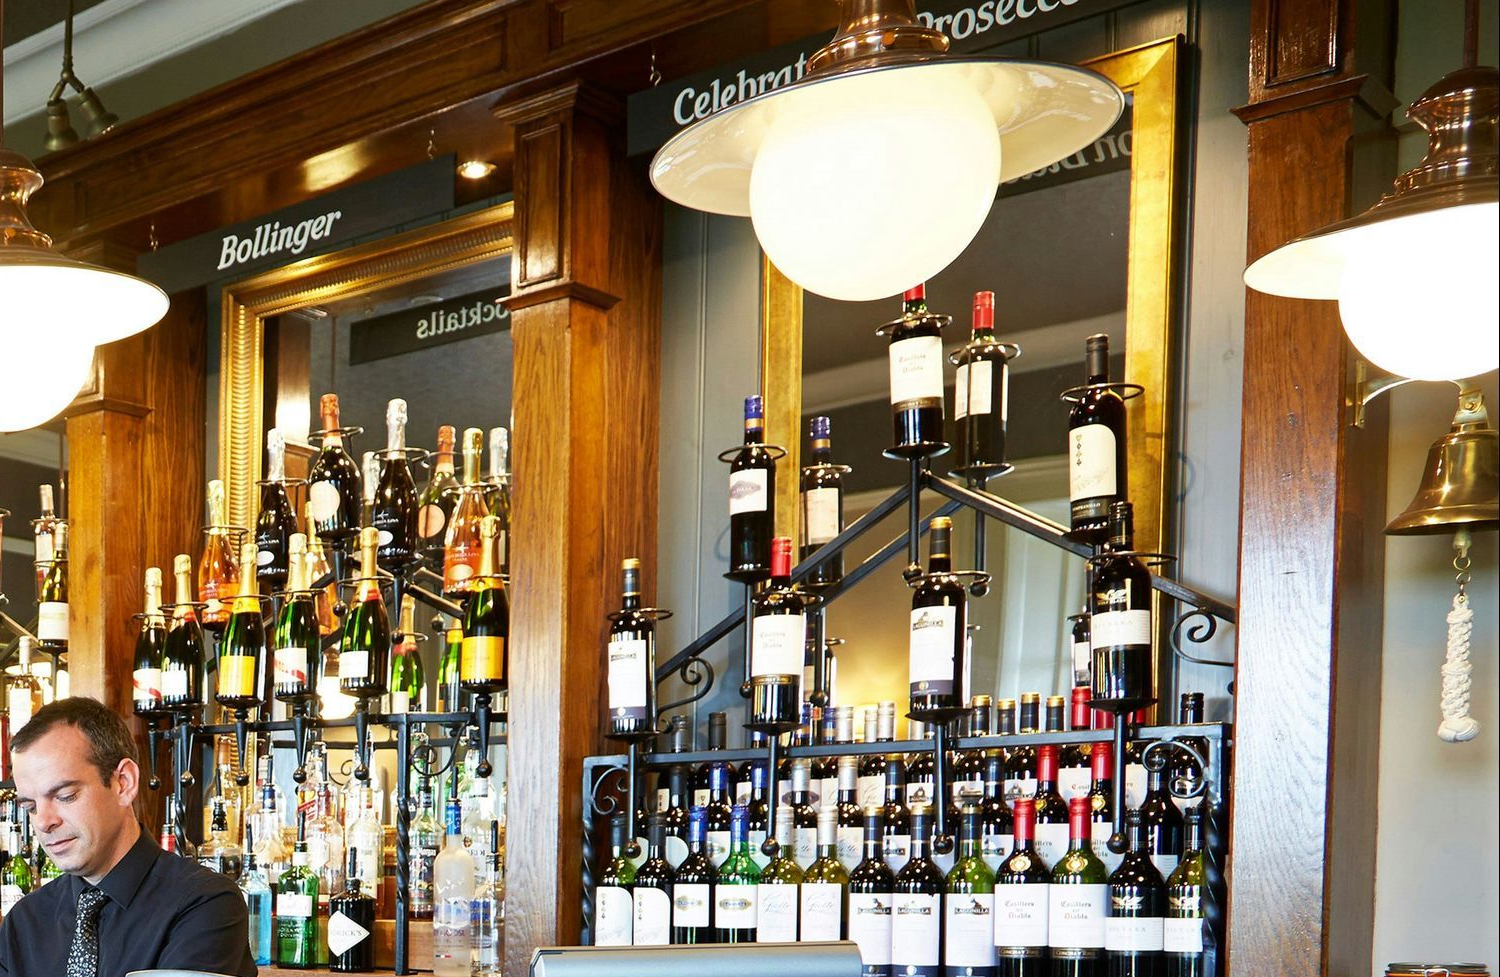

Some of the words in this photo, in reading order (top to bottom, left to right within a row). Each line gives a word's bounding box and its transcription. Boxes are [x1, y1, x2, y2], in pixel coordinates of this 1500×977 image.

[673, 51, 808, 126] Celebrat
[916, 0, 1082, 40] rosecc
[217, 210, 342, 271] Bollinger
